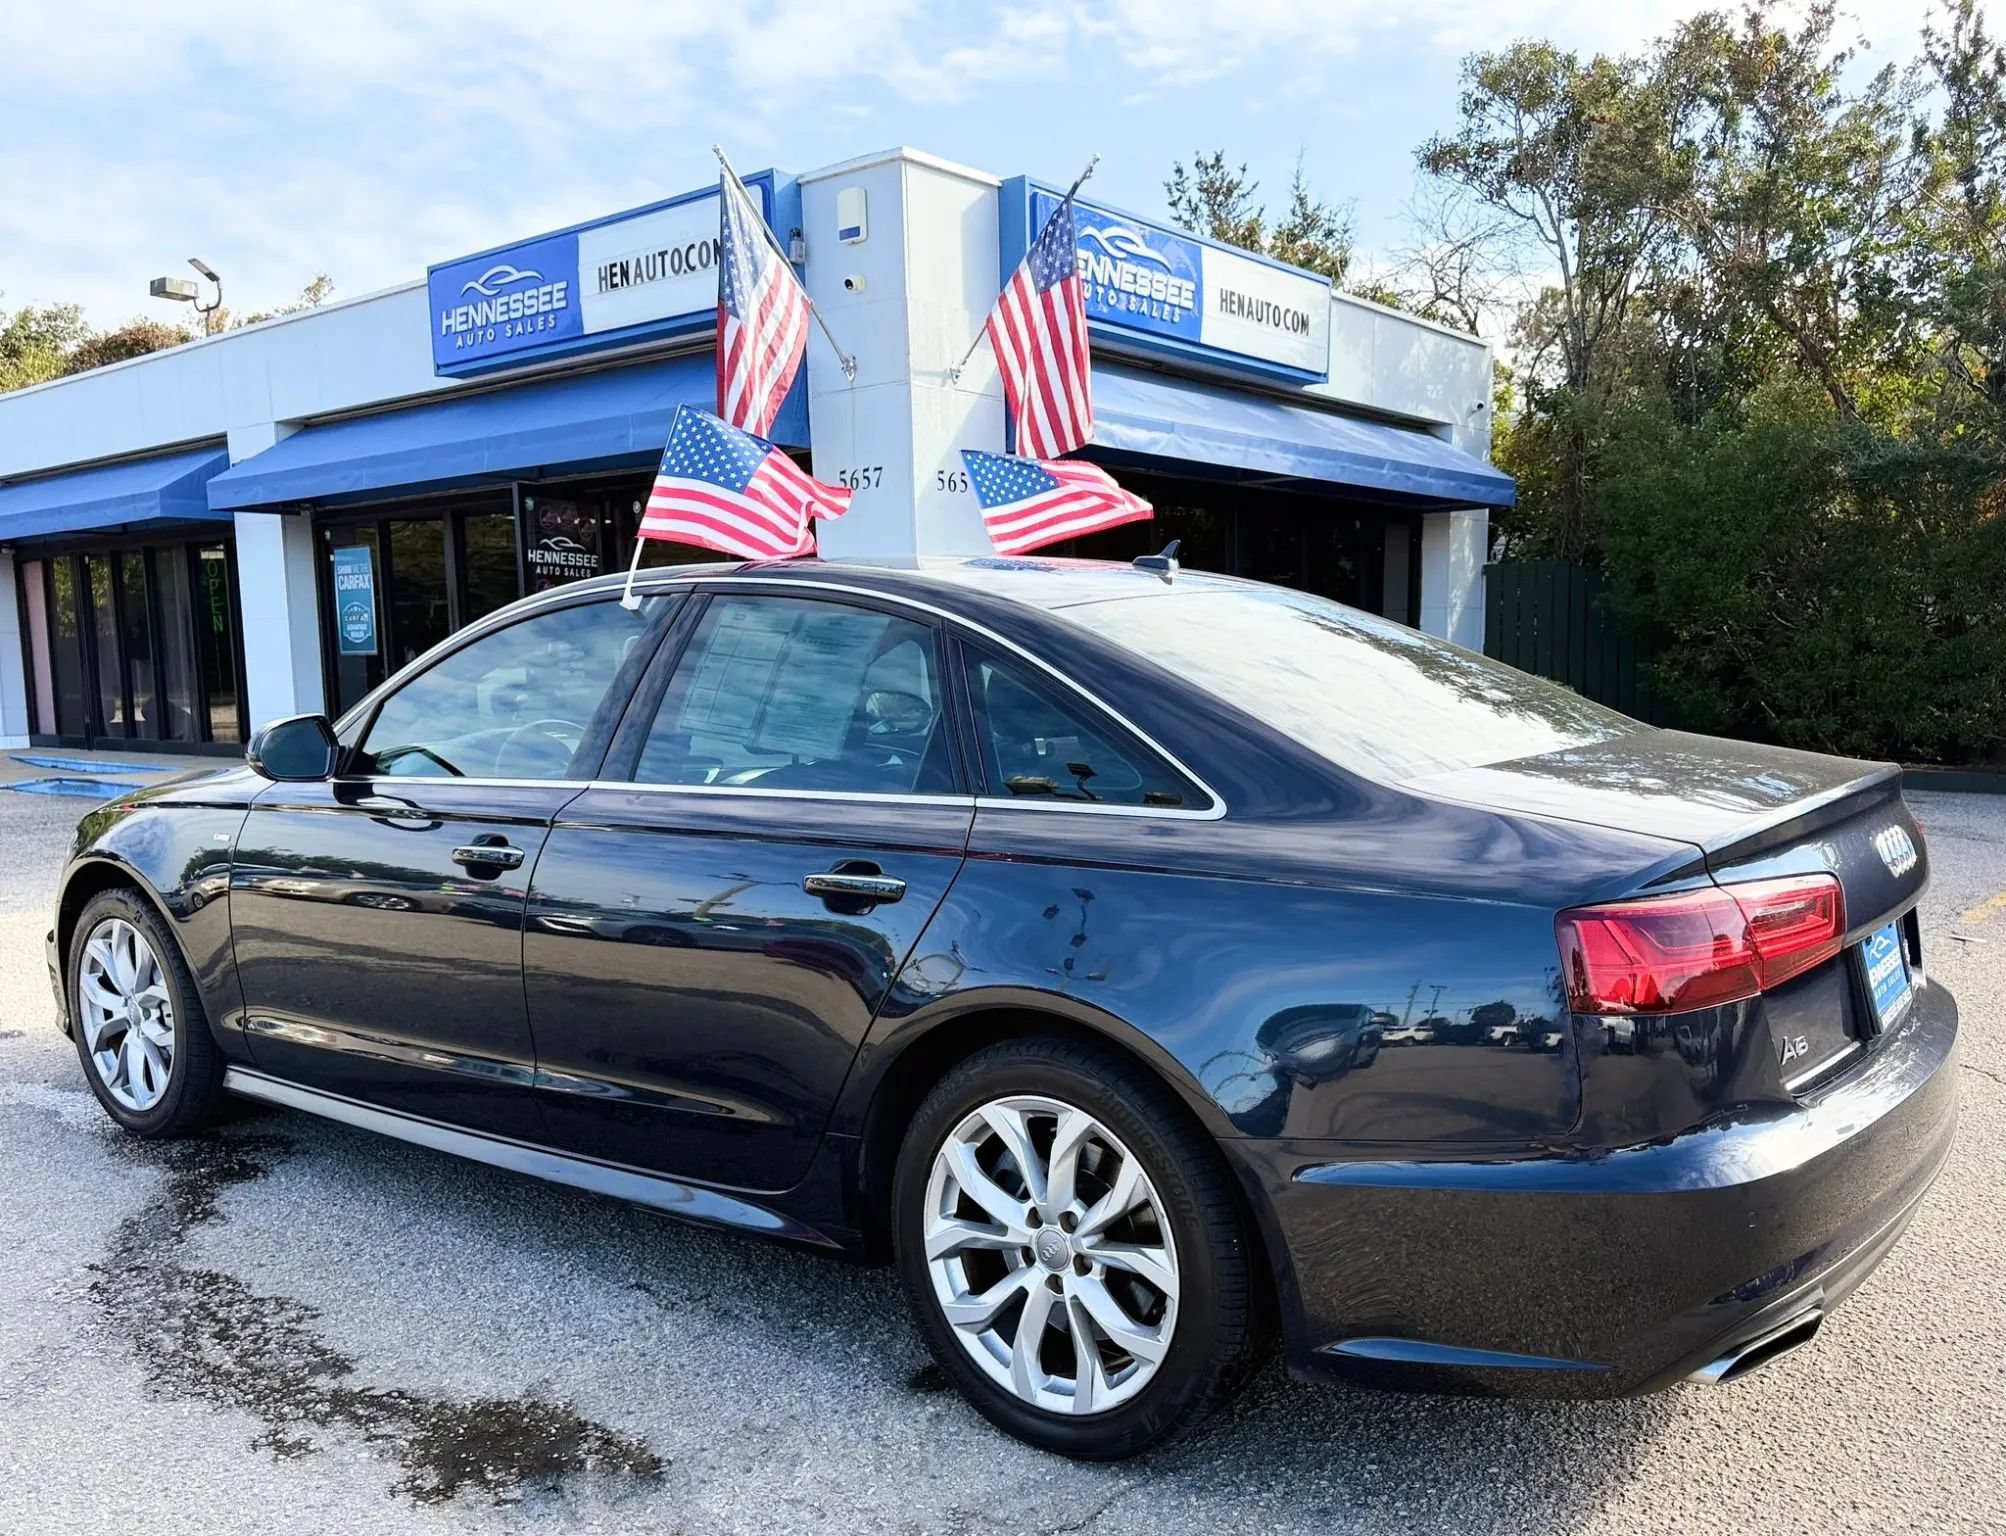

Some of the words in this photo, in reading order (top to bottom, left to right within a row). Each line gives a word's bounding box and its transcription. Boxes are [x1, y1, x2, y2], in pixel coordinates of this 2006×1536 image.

[1077, 248, 1196, 310] ENNESSEE
[442, 281, 568, 336] HENNESSEE
[1083, 282, 1117, 306] UTO
[1128, 295, 1180, 324] SALES
[456, 328, 496, 349] AUTO
[505, 314, 557, 339] SALES
[839, 466, 883, 491] 5657
[937, 469, 969, 493] 565
[528, 549, 599, 568] HENNESSEE
[536, 566, 560, 576] AUTO
[564, 567, 591, 578] SALES
[206, 560, 224, 633] OPEN
[338, 574, 370, 590] CARFAX
[1780, 1035, 1809, 1066] A6
